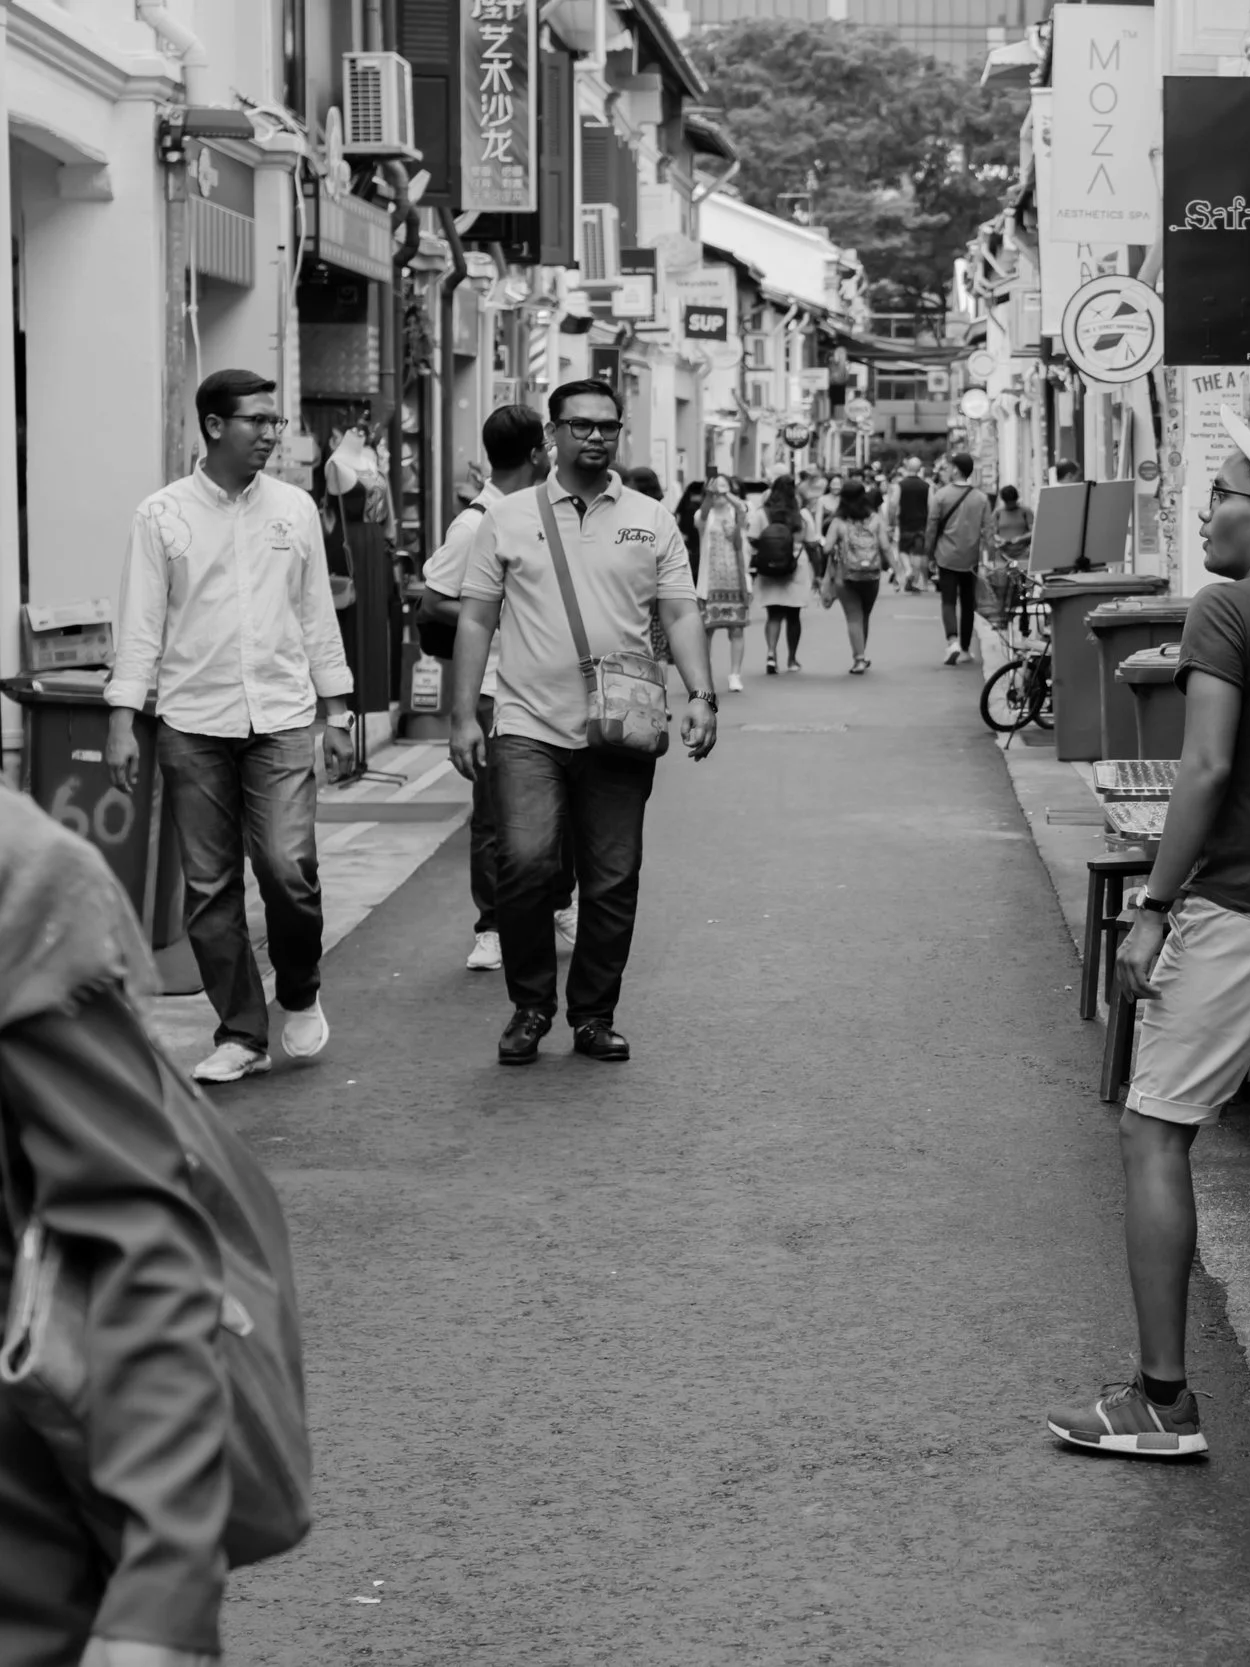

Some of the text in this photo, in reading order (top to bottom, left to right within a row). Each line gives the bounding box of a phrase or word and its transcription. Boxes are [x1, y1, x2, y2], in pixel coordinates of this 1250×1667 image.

[479, 23, 514, 162] 艺术沙龙
[1056, 209, 1151, 221] AESTHETICS SPA
[688, 313, 724, 333] SUP
[1192, 371, 1236, 394] THE A
[51, 776, 135, 844] 60
